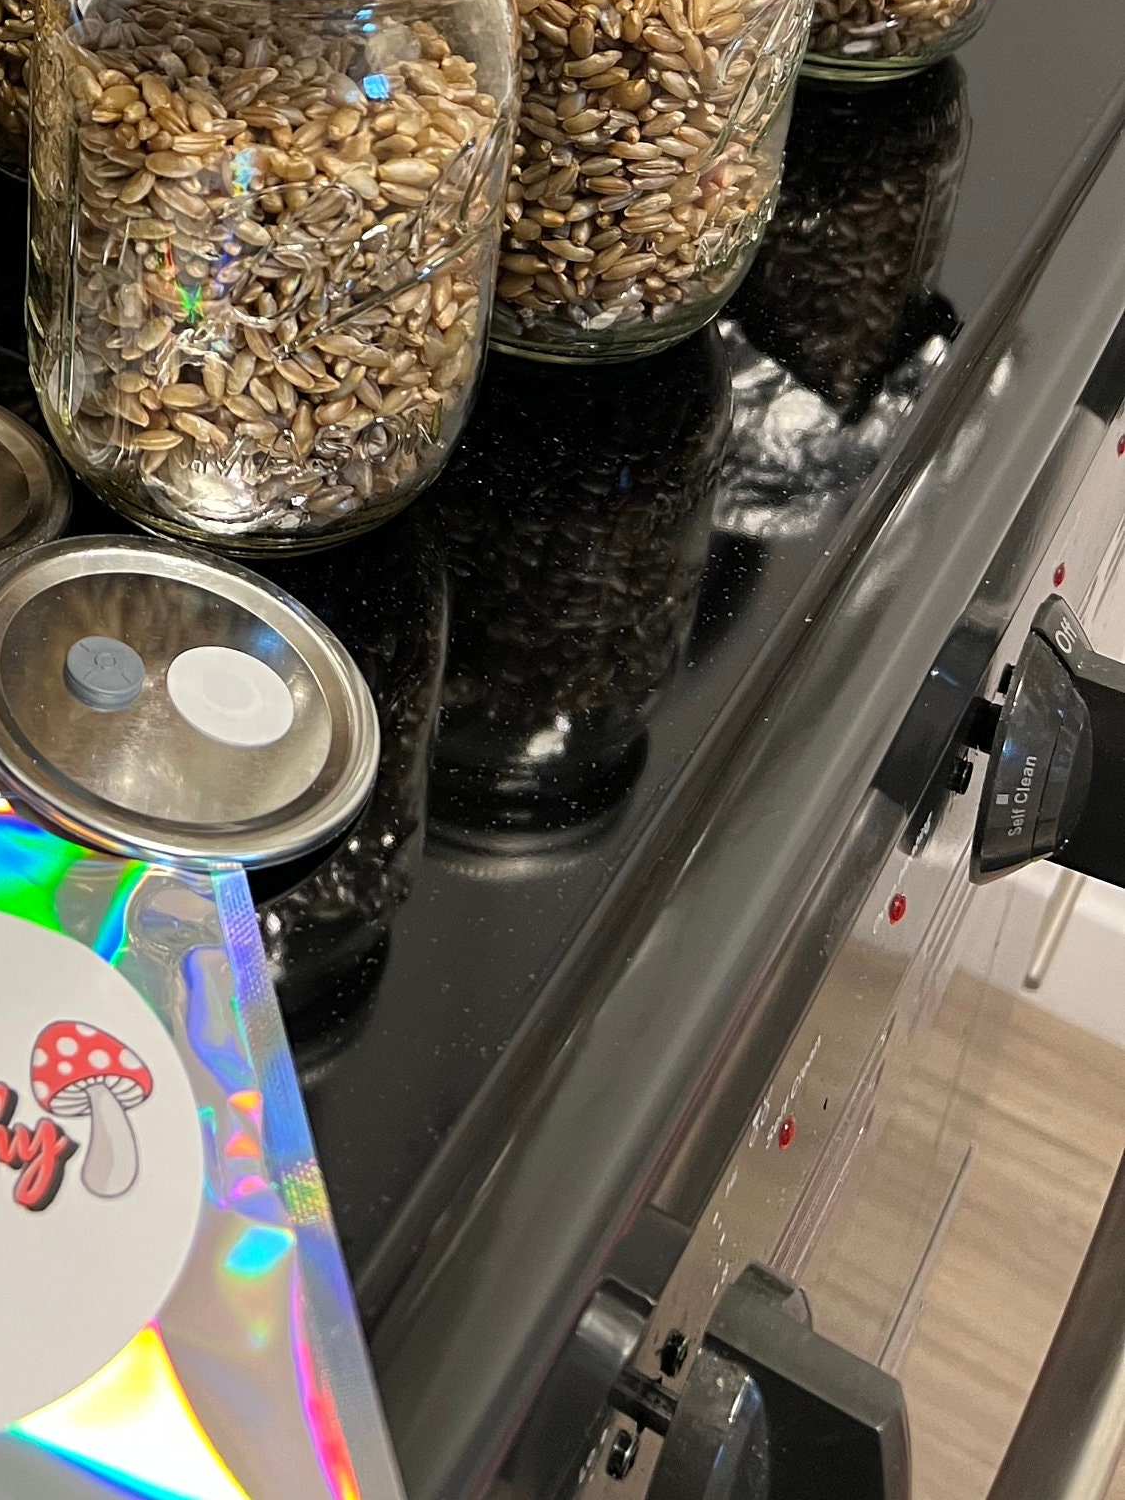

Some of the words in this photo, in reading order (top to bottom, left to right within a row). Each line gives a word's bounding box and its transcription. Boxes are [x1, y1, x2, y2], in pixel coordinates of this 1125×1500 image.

[1054, 616, 1078, 654] Off
[1013, 755, 1038, 804] Clean
[1007, 807, 1026, 838] Self
